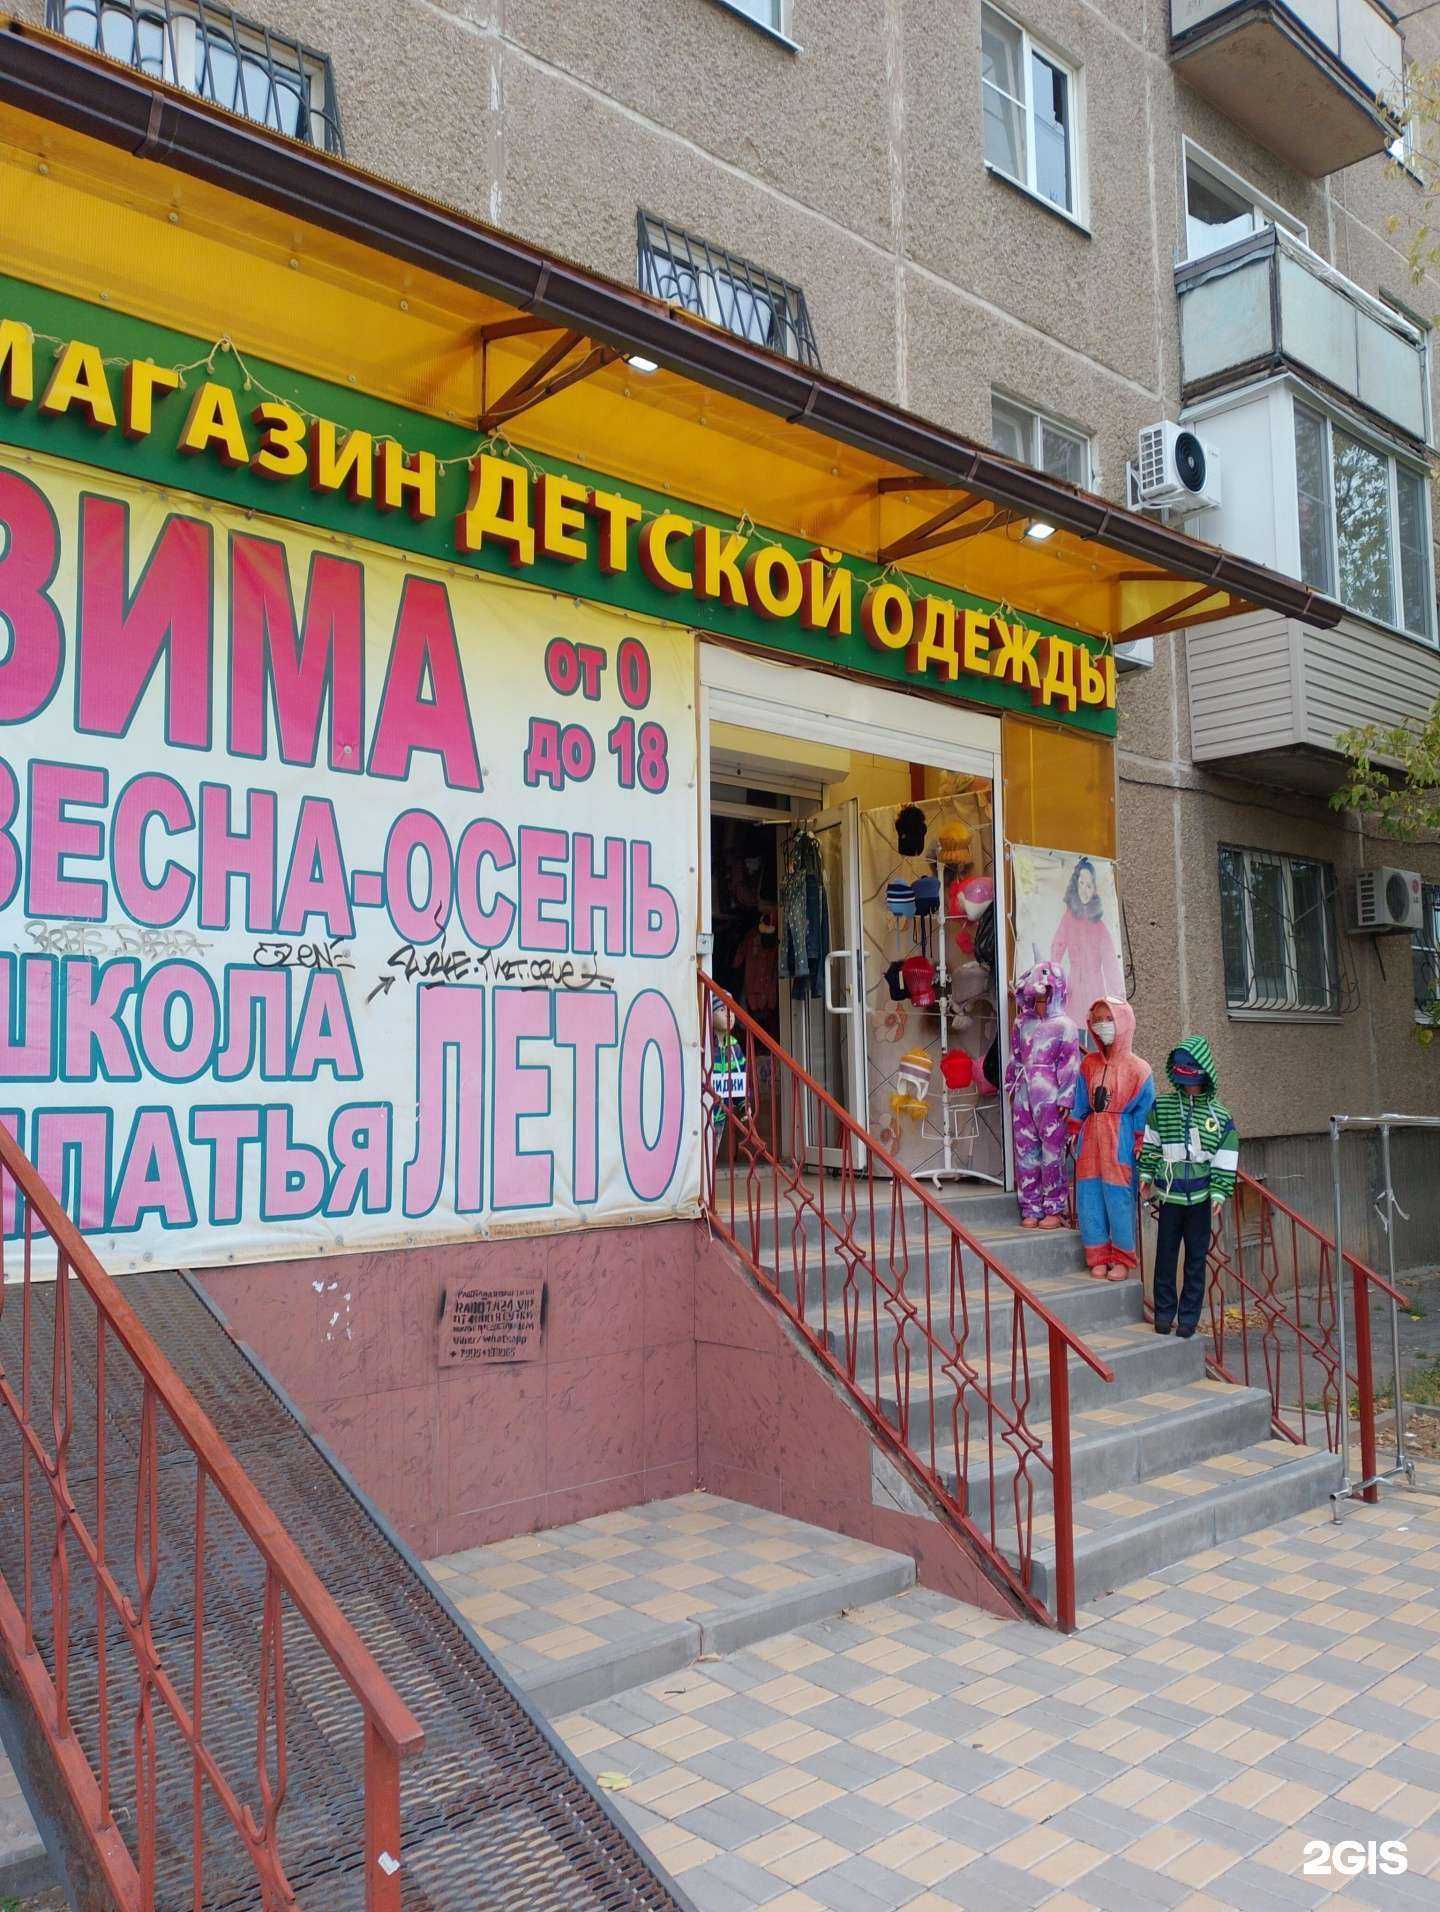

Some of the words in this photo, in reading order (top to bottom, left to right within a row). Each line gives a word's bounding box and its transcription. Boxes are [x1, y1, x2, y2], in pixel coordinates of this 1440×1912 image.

[456, 453, 852, 637] ДЕТСКОЙ
[861, 582, 1117, 711] ОДЕЖДЫ
[608, 716, 669, 794] 18
[616, 637, 652, 710] 0
[0, 757, 680, 959] ЕСНА-ОСЕНЬ
[0, 1102, 393, 1241] ЛАТЬЯ
[403, 981, 685, 1218] ЛЕТО
